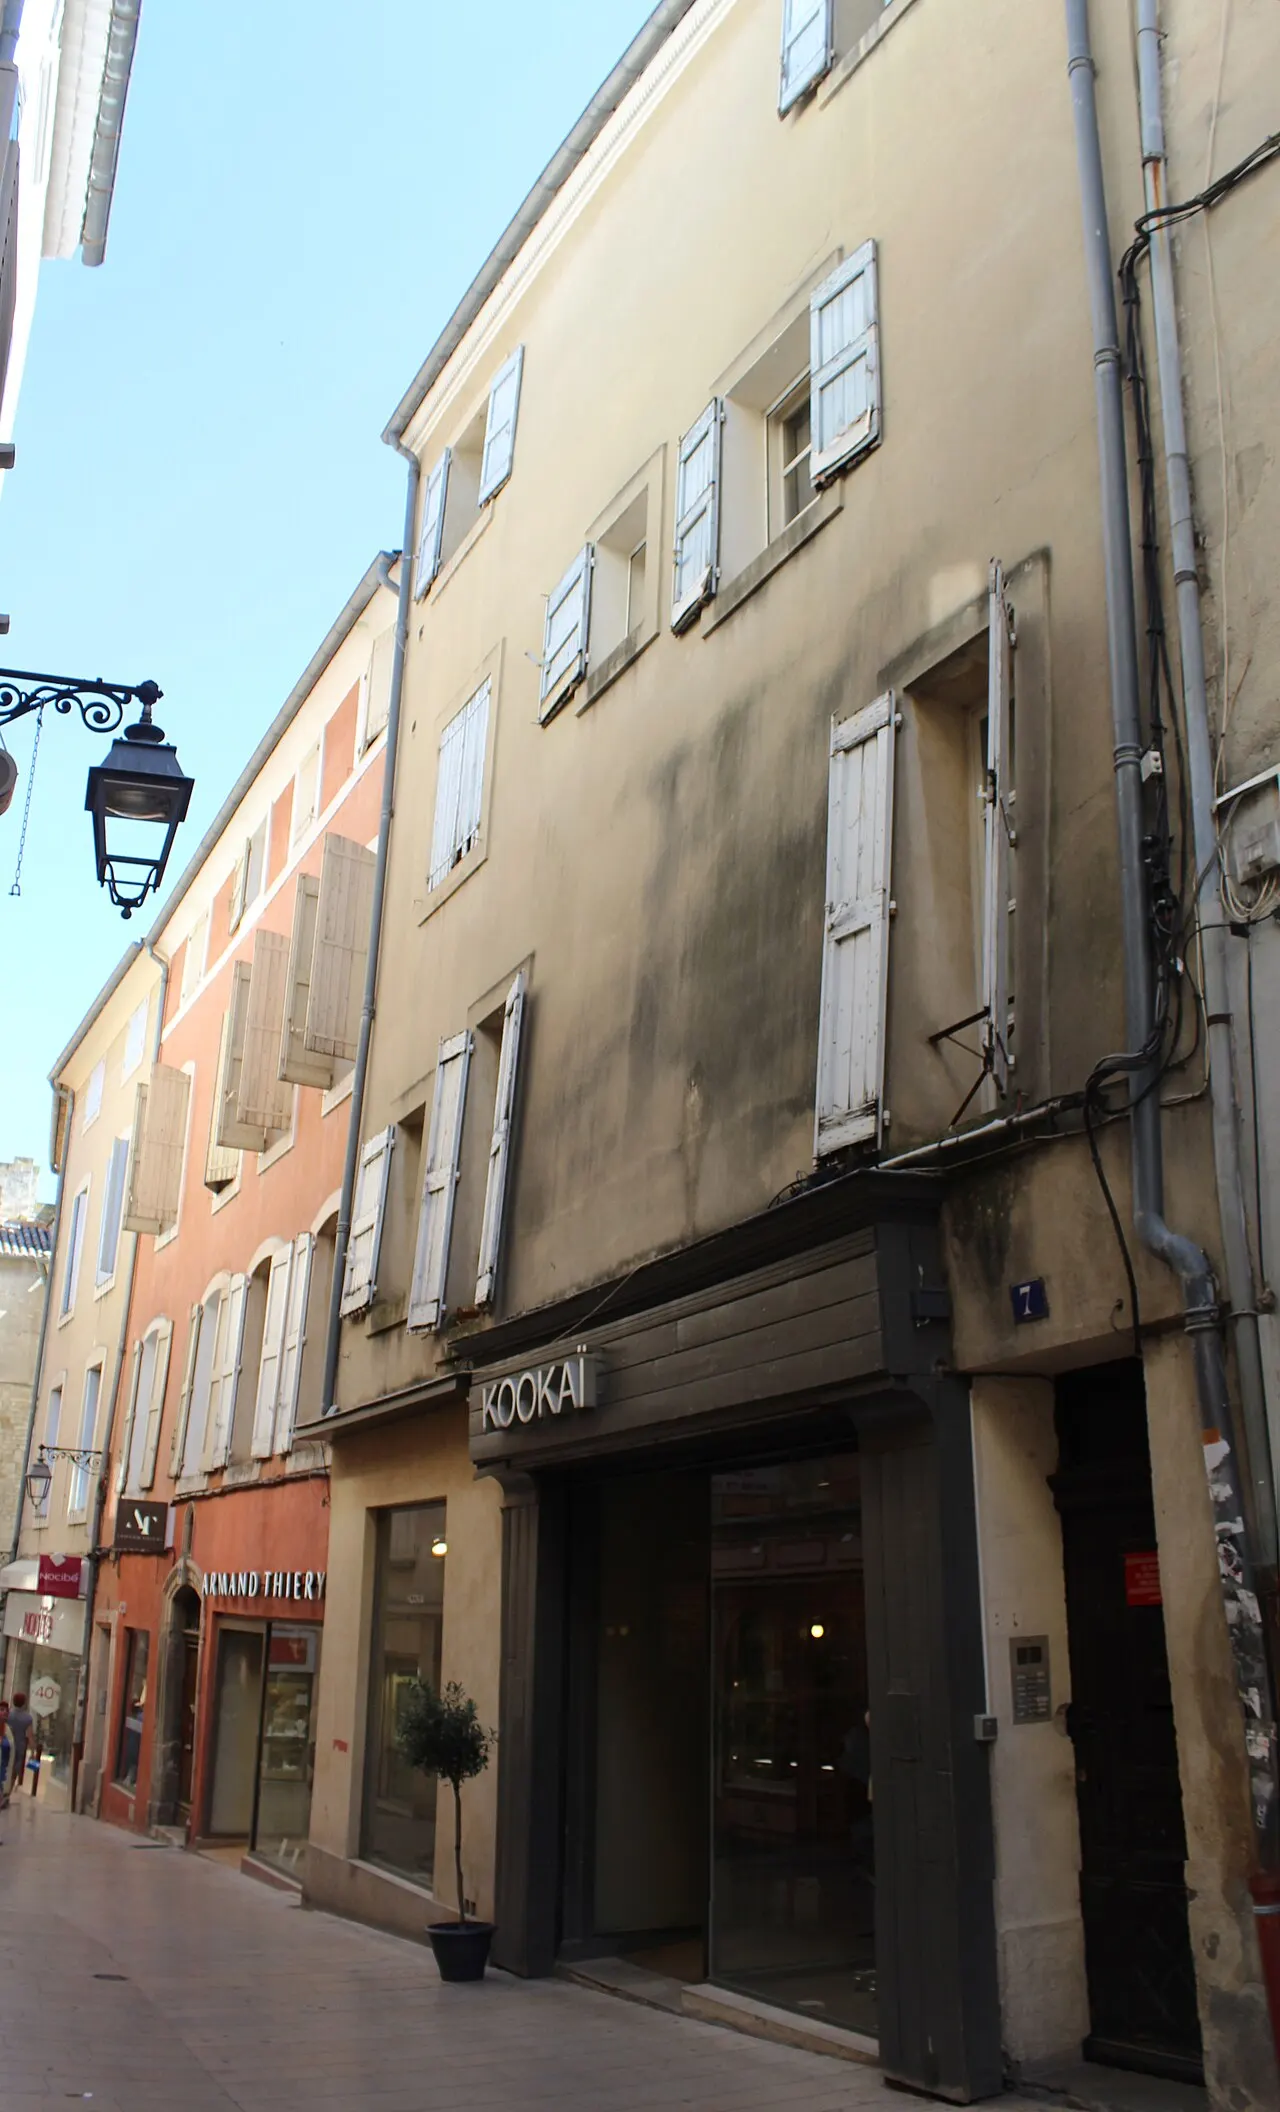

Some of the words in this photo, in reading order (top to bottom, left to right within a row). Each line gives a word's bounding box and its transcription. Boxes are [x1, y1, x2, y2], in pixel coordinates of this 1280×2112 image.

[1020, 1285, 1032, 1315] 7
[482, 1344, 587, 1430] KOOKAÏ
[201, 1571, 259, 1597] ARMAND
[264, 1571, 325, 1600] THIERY
